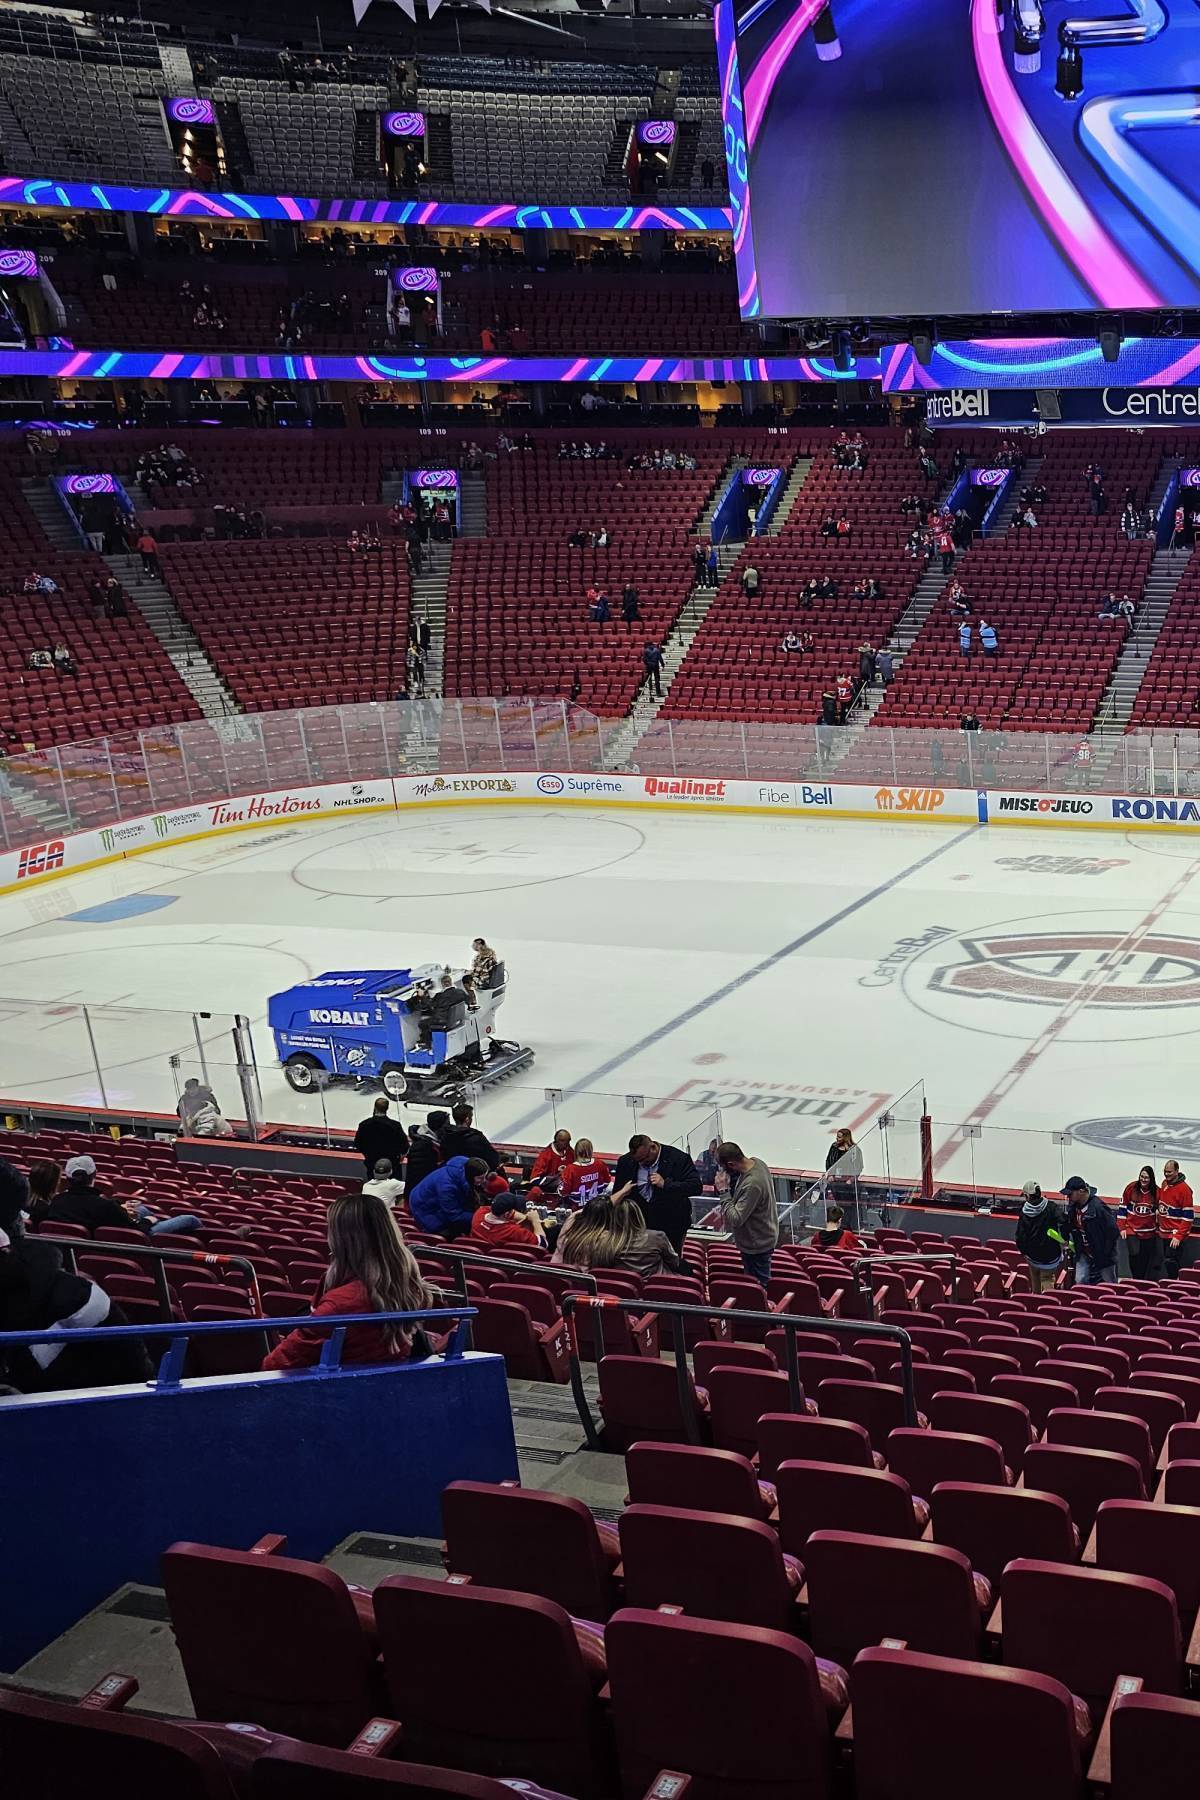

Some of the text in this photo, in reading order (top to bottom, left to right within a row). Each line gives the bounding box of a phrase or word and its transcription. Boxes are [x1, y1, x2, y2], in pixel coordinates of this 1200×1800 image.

[39, 255, 54, 263] 209
[374, 268, 388, 276] 209
[439, 270, 451, 278] 210
[540, 779, 561, 790] Esso
[645, 777, 726, 796] Qualinet
[759, 787, 790, 803] Fibe
[802, 786, 833, 805] Bell
[896, 787, 945, 811] SKIP
[208, 797, 322, 826] Tim Hortons
[17, 841, 66, 879] IGA
[858, 925, 958, 989] CentreBell
[309, 1009, 370, 1026] KOBALT
[716, 1080, 868, 1098] ASSURANCE
[686, 1089, 857, 1126] intact
